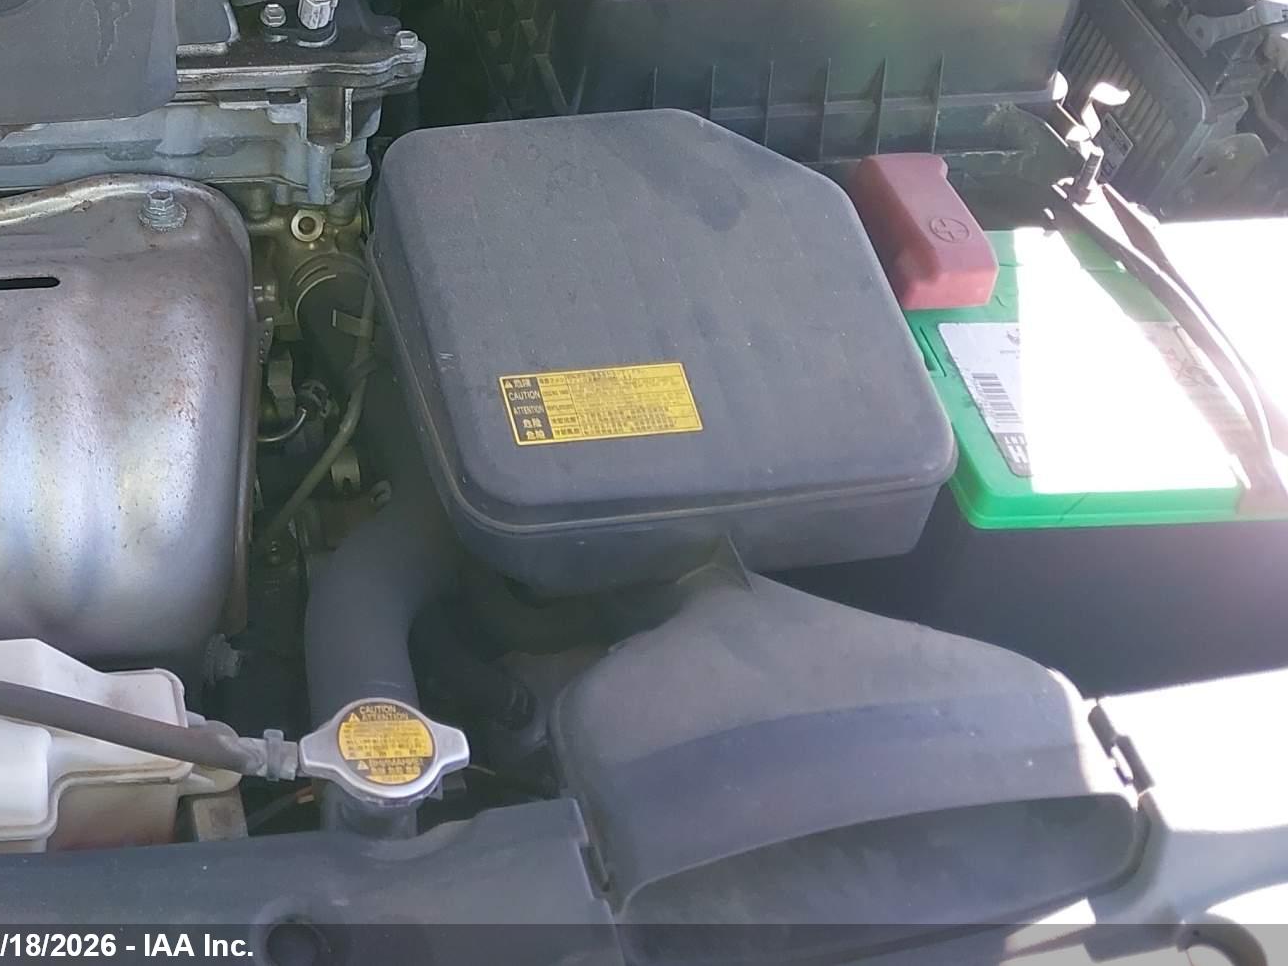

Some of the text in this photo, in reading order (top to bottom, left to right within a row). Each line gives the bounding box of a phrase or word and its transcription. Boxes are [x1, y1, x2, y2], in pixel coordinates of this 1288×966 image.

[509, 390, 541, 401] CAUTION
[513, 405, 545, 415] ATTENTION
[359, 705, 396, 715] CAUTION
